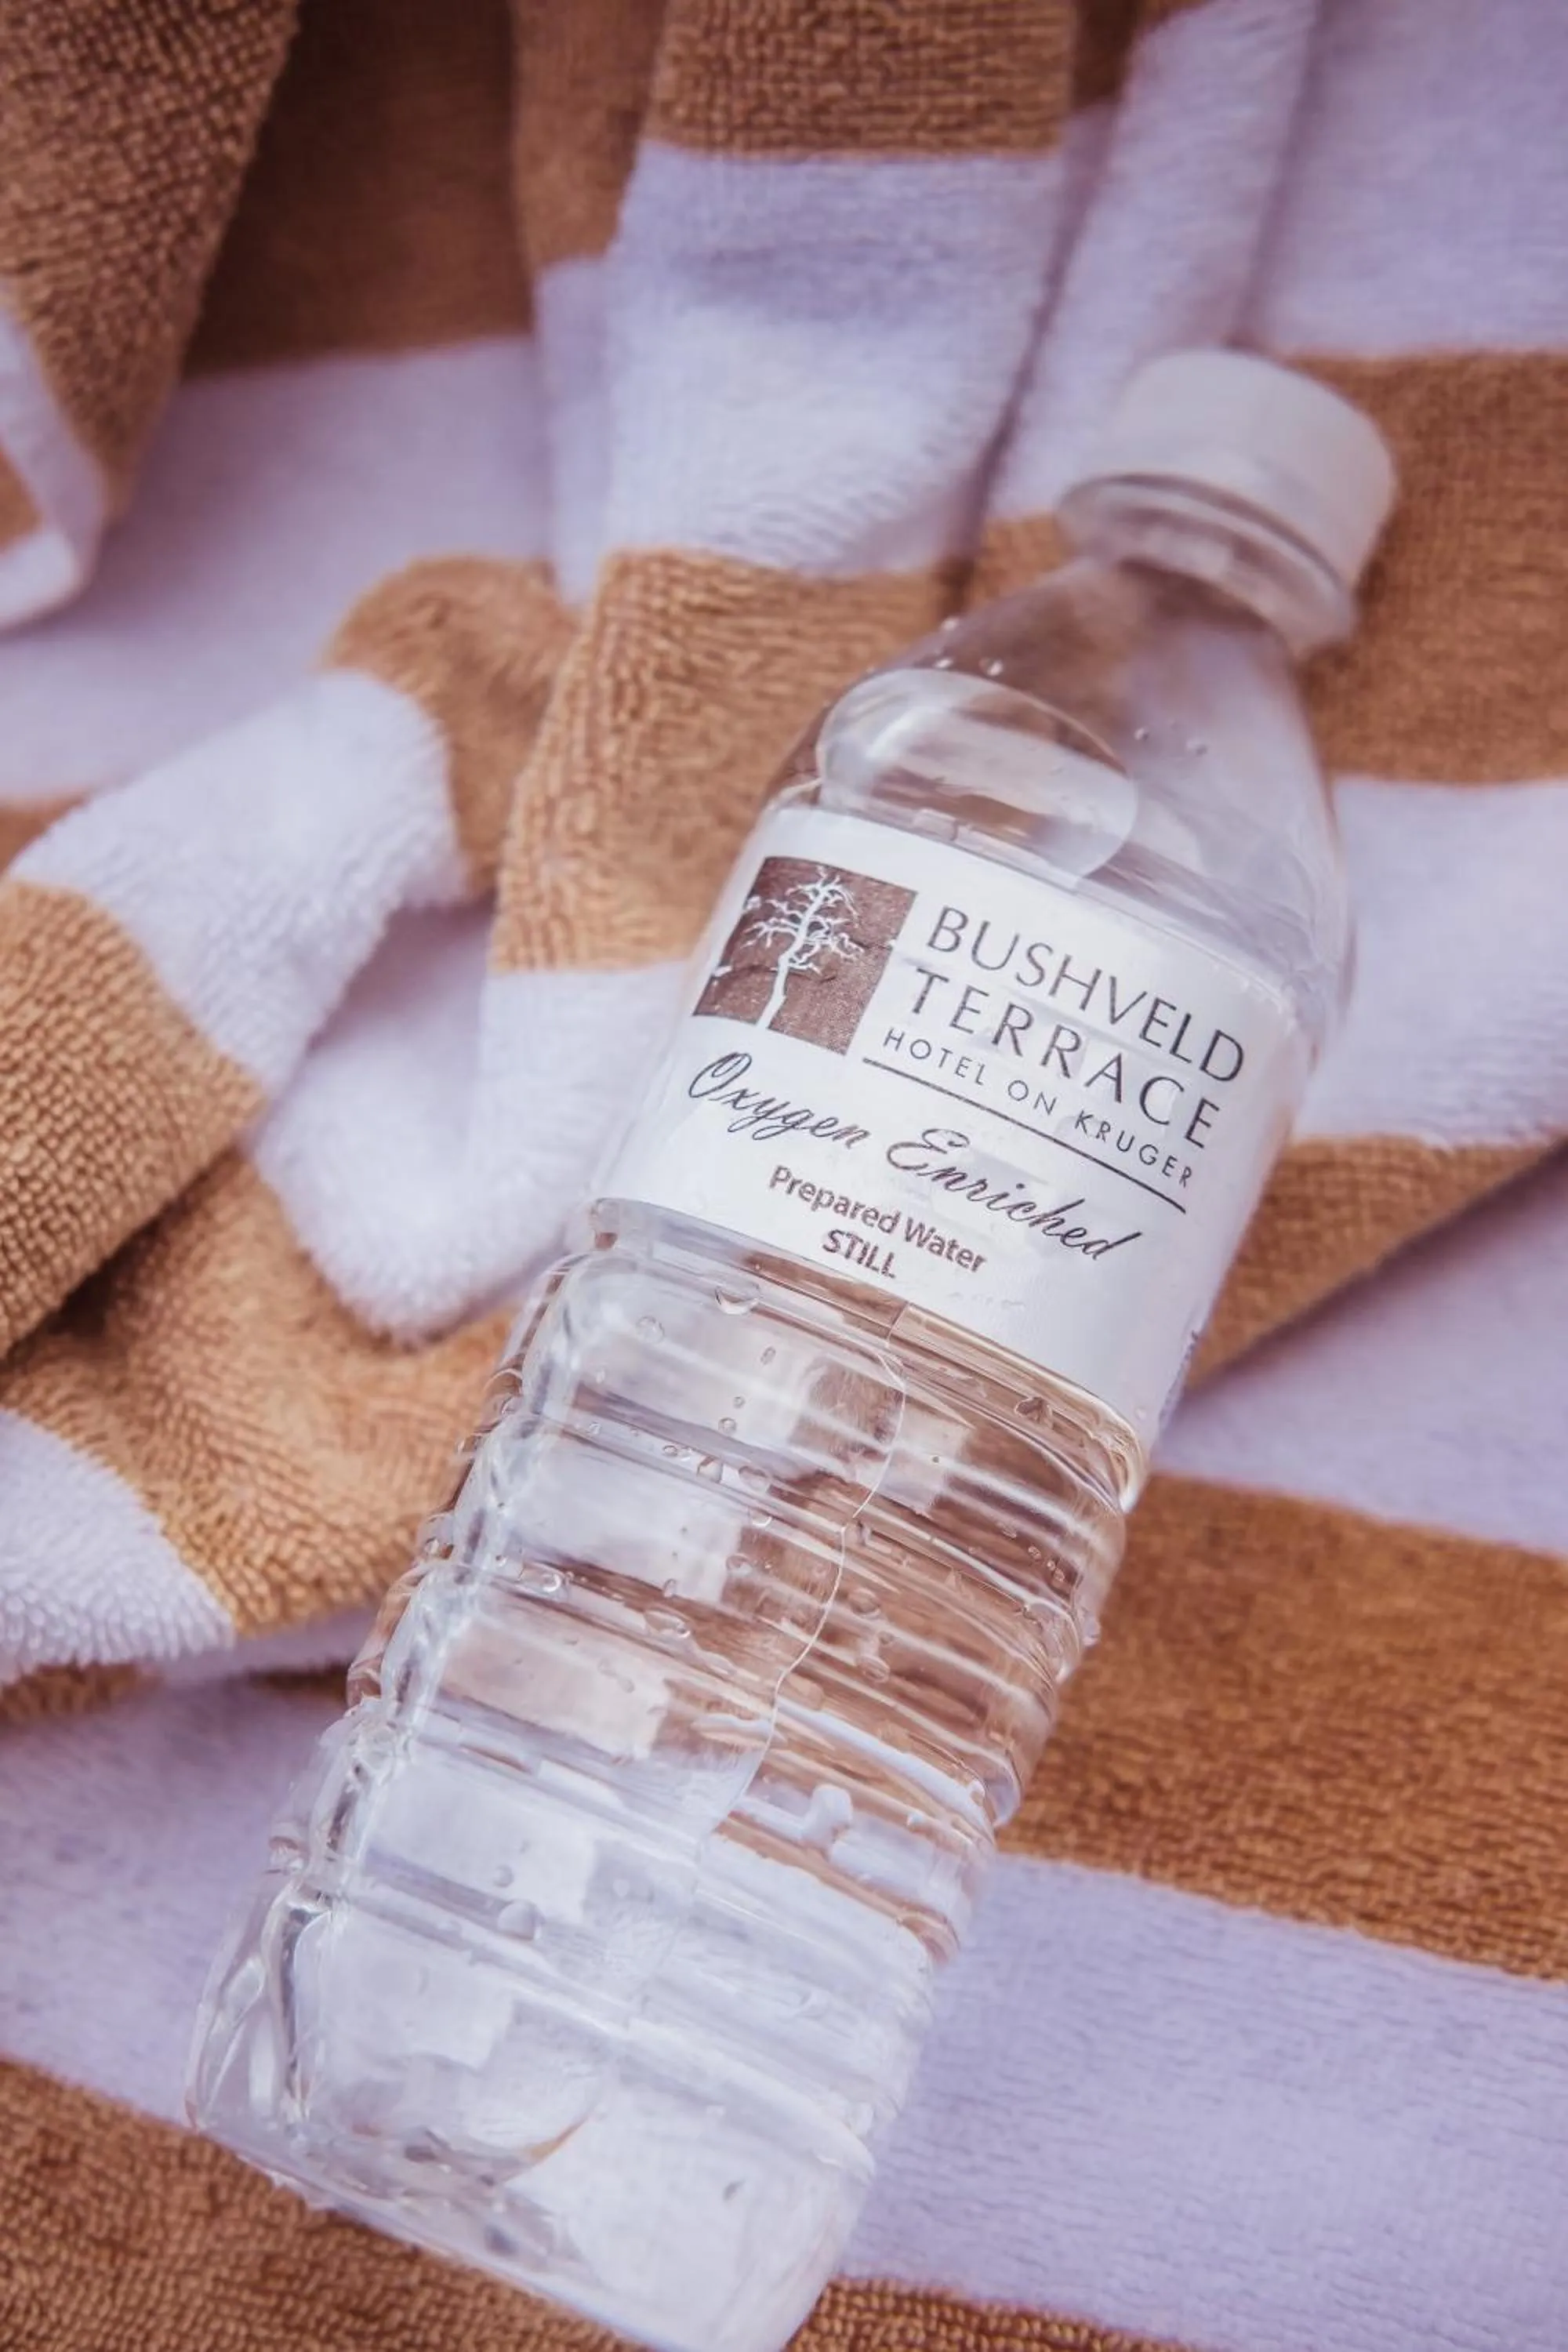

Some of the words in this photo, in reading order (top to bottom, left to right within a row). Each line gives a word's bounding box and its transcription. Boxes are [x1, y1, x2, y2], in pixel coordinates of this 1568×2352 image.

[912, 968, 1221, 1149] TERRACE
[927, 906, 1245, 1083] BUSHVELD
[688, 1052, 869, 1148] Oxygen
[887, 1128, 1142, 1260] Enriched
[884, 1028, 985, 1085] HOTEL
[1008, 1080, 1056, 1116] ON
[1075, 1111, 1192, 1187] KRUGER
[770, 1166, 899, 1234] Prepared
[903, 1218, 987, 1272] Water
[822, 1229, 896, 1278] STILL
